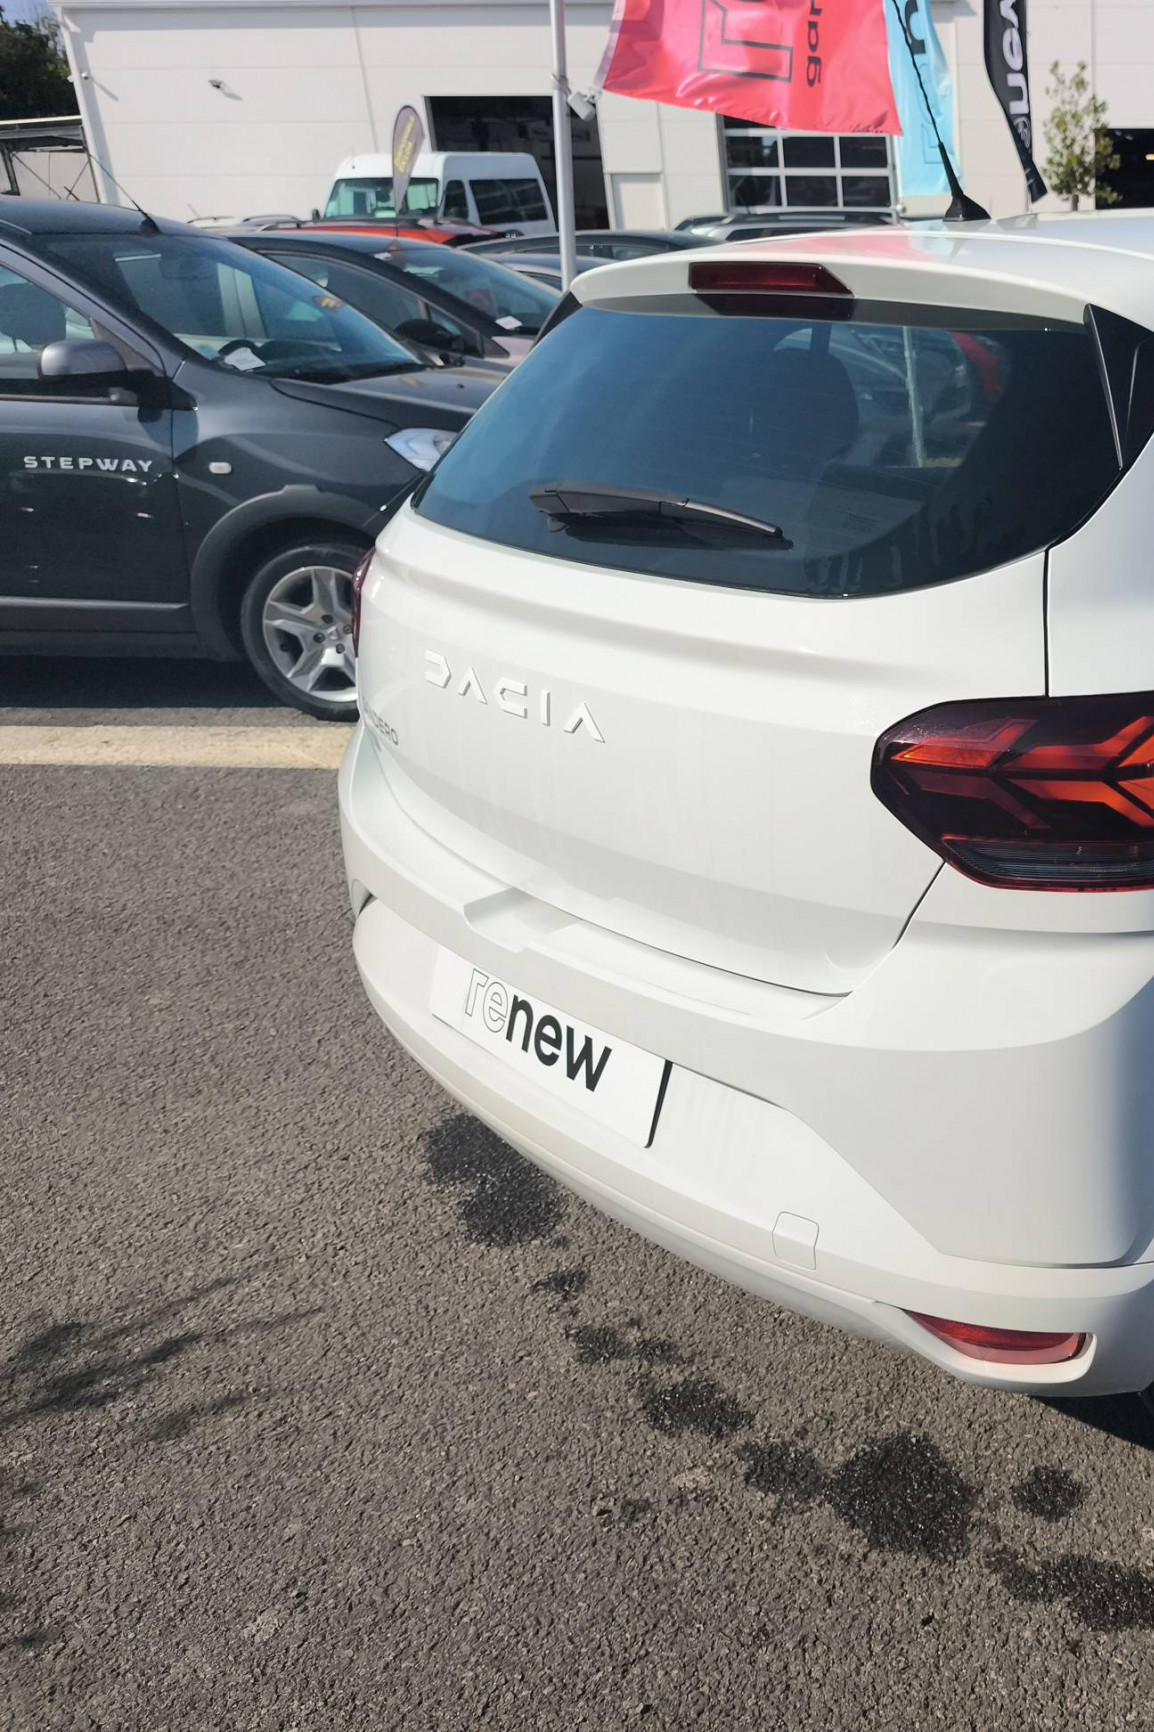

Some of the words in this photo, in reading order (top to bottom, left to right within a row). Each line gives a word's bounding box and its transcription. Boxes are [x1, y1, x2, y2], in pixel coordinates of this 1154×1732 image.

[24, 456, 152, 472] STEPWAY
[424, 649, 605, 743] DACIA
[465, 968, 612, 1092] renew
